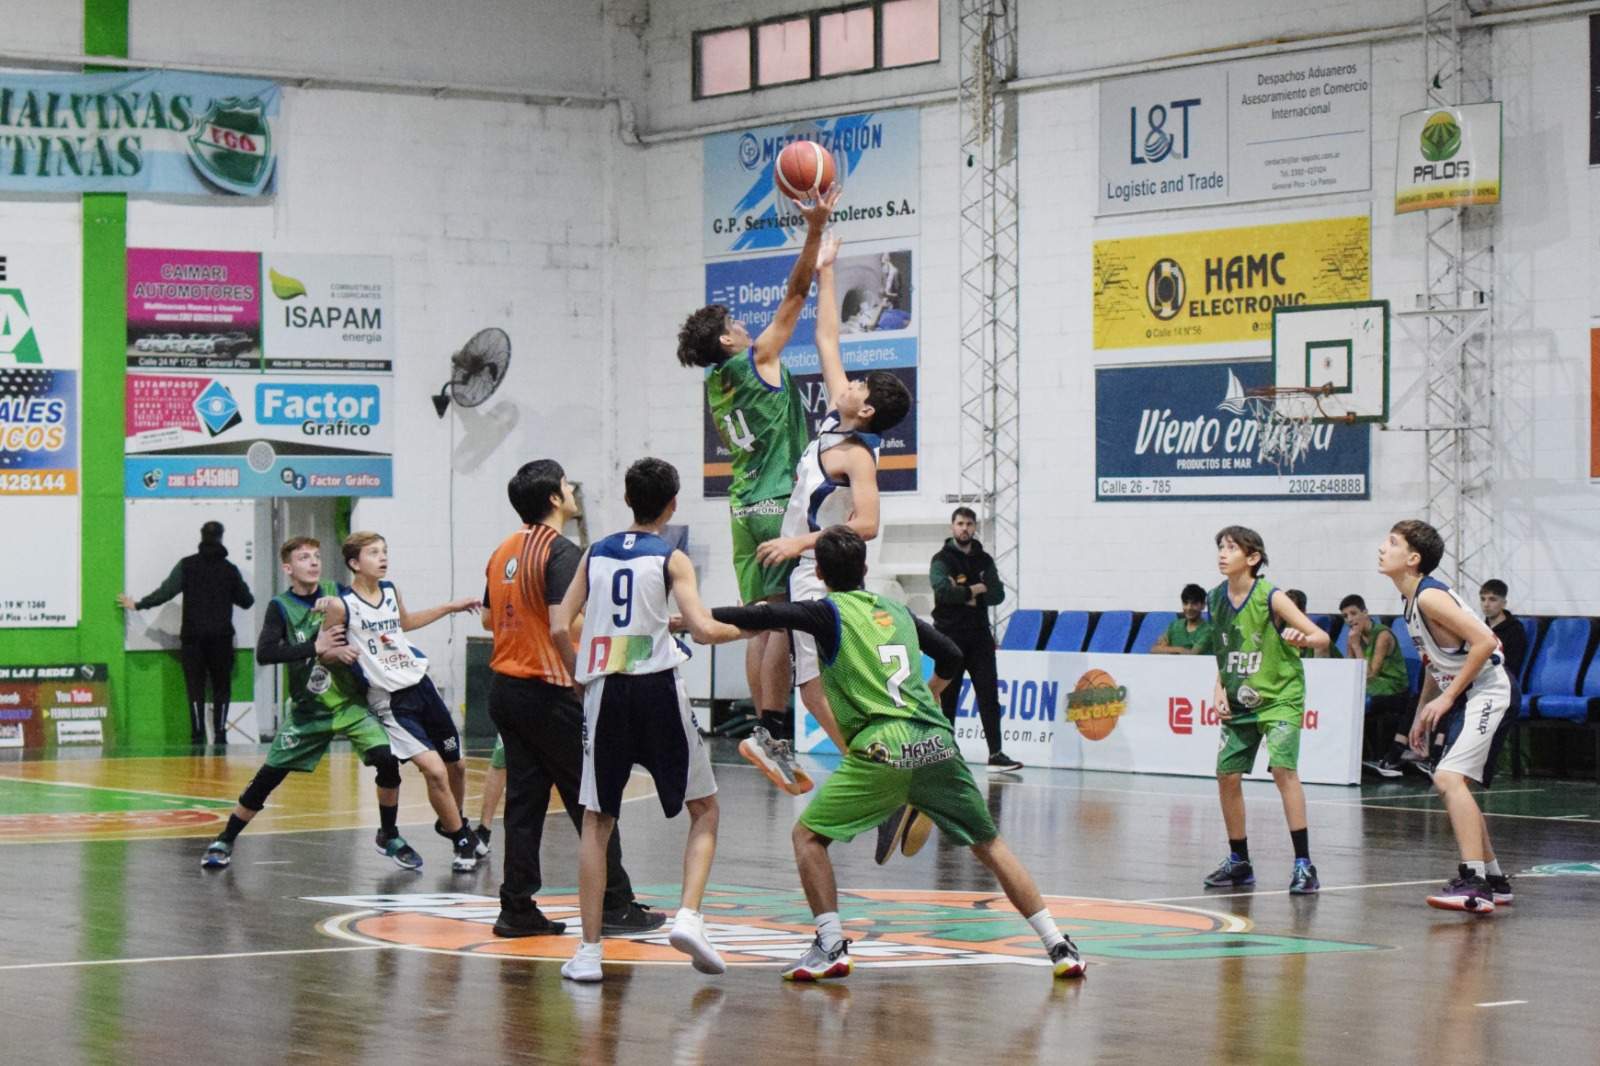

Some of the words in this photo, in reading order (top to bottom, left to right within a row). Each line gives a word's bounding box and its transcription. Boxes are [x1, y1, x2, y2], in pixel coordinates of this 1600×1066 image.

[1257, 70, 1306, 87] Despachos
[1308, 64, 1357, 79] Aduaneros
[1241, 87, 1308, 105] Asesoramiento
[1309, 86, 1322, 97] en
[1323, 80, 1368, 96] Comercio
[0, 88, 195, 132] ALVINAS
[1271, 101, 1331, 119] Internacional
[1130, 98, 1202, 165] L&T
[1413, 161, 1470, 184] PALOS
[1107, 179, 1157, 201] Logistic
[1160, 175, 1184, 193] and
[1188, 172, 1224, 190] Trade
[713, 217, 742, 234] G.P.
[745, 212, 805, 232] Servicios
[886, 199, 916, 217] S.A.
[161, 264, 228, 281] CAIMARI
[1205, 251, 1286, 294] HAMC
[135, 282, 255, 301] AUTOMOTORES
[285, 306, 382, 329] ISAPAM
[843, 348, 898, 365] imágenes.
[263, 388, 375, 420] Factor
[302, 420, 371, 436] Gráfico
[1134, 408, 1220, 455] Viento
[1225, 419, 1258, 453] en
[1176, 459, 1220, 470] PRODUCTOS
[1221, 459, 1232, 469] DE
[1233, 458, 1252, 469] MAR
[310, 475, 341, 487] Factor
[1101, 479, 1128, 494] Calle
[1130, 480, 1142, 494] 26
[1152, 480, 1172, 494] 785
[1288, 479, 1361, 494] 2302-648888
[611, 567, 634, 628] 9
[367, 638, 378, 656] 6
[12, 668, 35, 678] LAS
[37, 668, 76, 678] REDES
[877, 645, 911, 708] 7
[900, 735, 945, 760] HAMC
